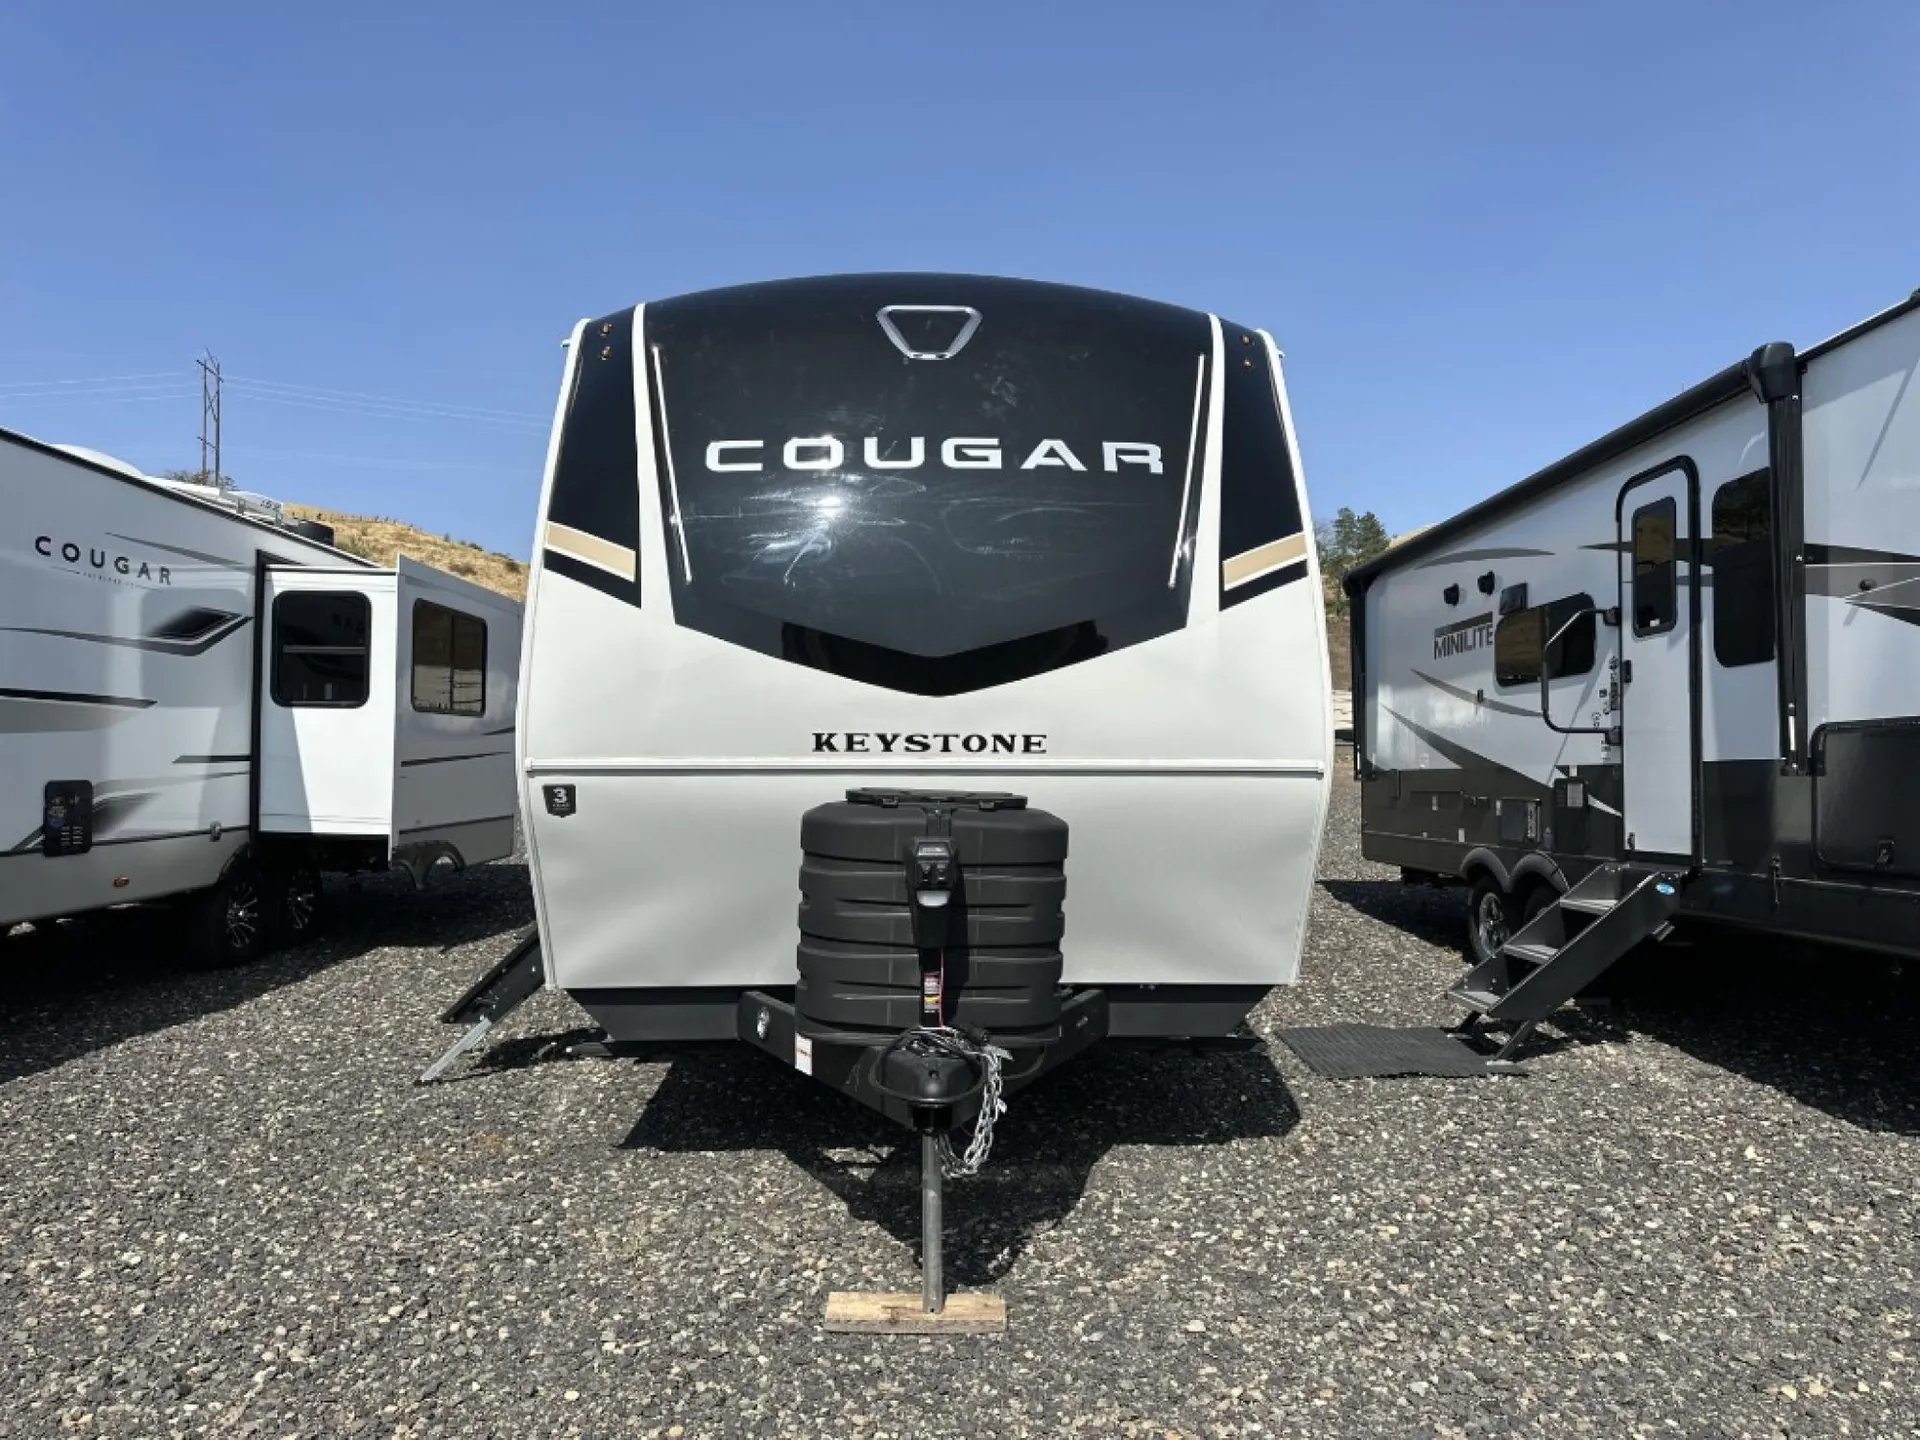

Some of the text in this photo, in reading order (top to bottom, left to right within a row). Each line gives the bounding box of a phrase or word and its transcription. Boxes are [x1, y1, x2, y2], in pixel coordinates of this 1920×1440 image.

[705, 436, 1164, 475] COUGAR
[35, 535, 172, 586] COUGAR
[1433, 623, 1494, 661] MINILITE
[811, 732, 1048, 754] KEYSTONE
[552, 787, 567, 803] 3
